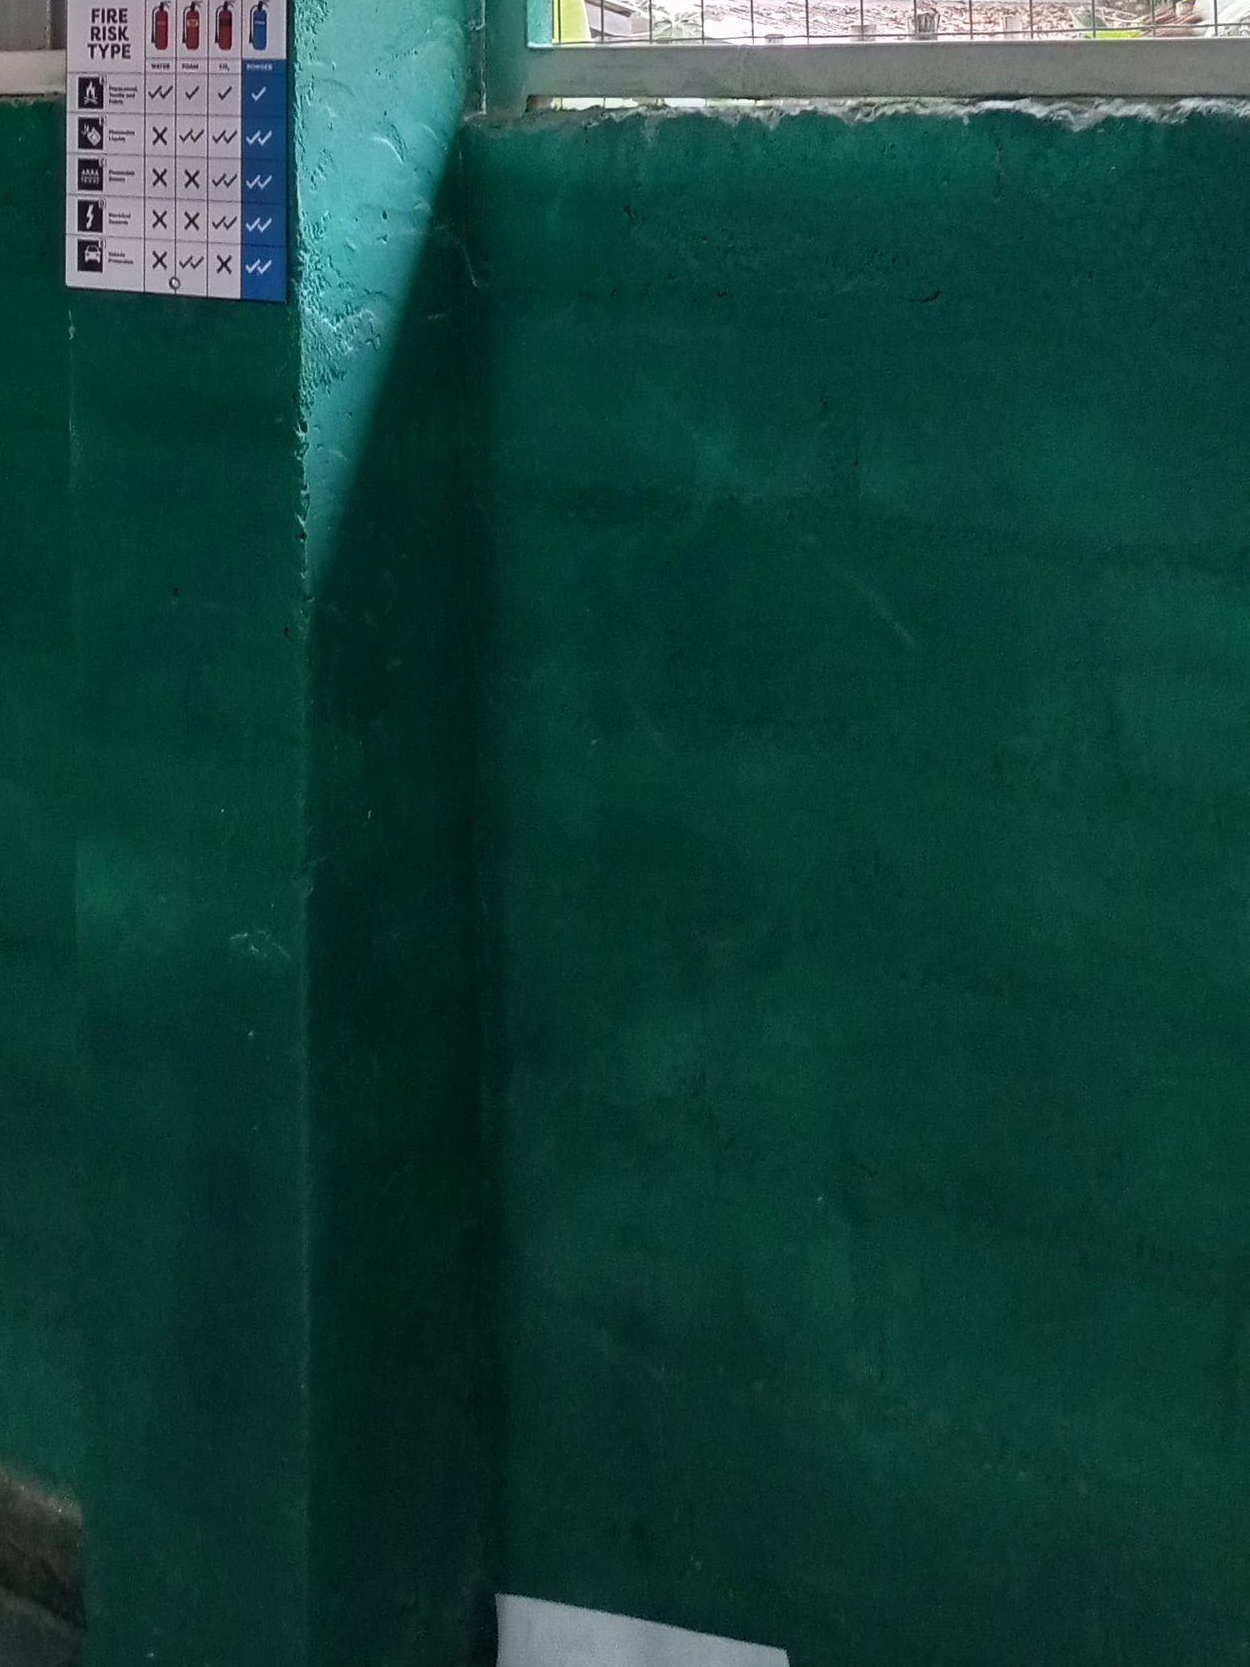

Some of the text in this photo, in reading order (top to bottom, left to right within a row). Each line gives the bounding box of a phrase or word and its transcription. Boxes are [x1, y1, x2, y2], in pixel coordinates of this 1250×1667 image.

[91, 8, 128, 24] FIRE
[90, 25, 129, 42] RISK
[87, 43, 131, 60] TYPE
